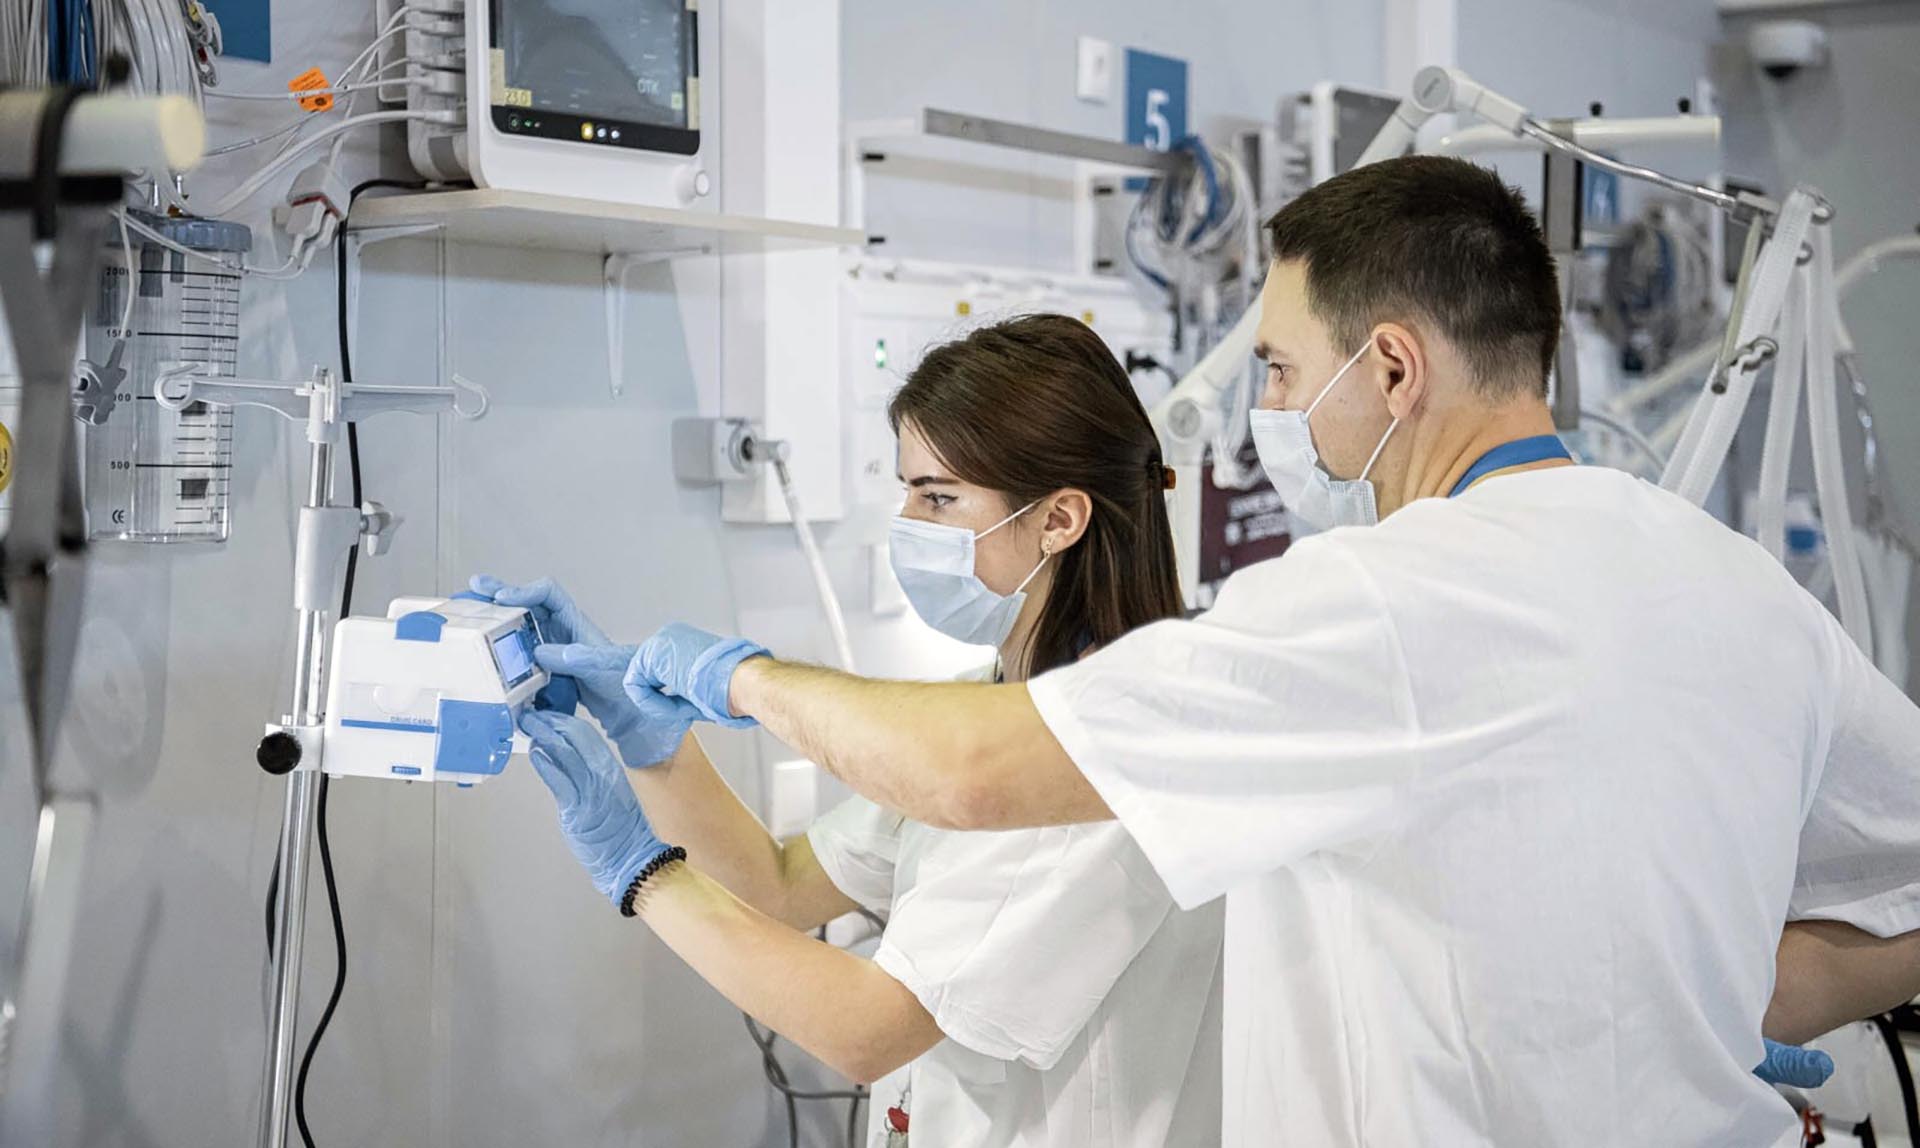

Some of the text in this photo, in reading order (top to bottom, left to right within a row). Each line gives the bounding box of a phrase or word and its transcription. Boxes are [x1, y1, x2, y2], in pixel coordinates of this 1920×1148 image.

[1144, 88, 1171, 153] 5
[106, 267, 129, 276] 200
[106, 329, 132, 338] 150
[110, 461, 130, 470] 500
